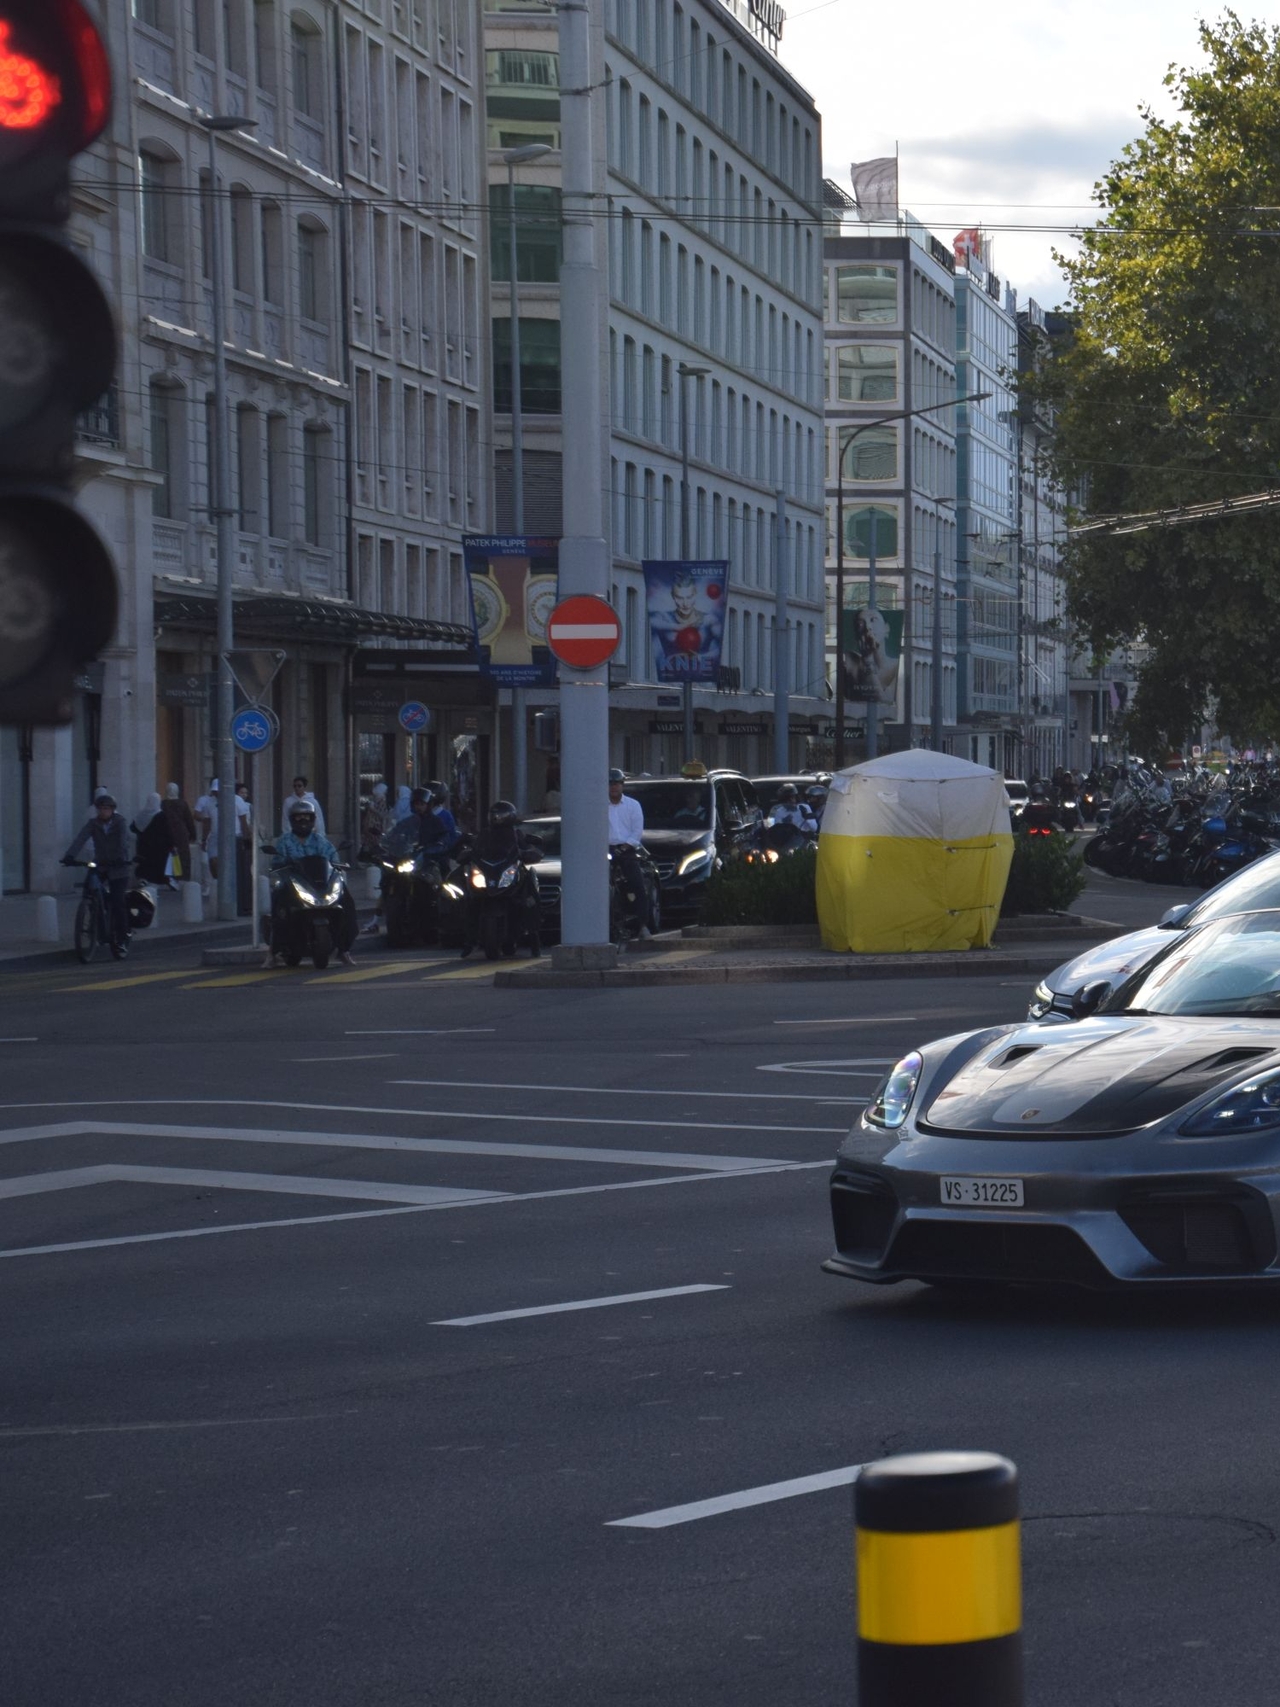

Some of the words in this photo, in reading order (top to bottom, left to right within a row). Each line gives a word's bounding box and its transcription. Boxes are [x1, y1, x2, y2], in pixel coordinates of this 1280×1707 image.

[465, 539, 490, 547] PATEK
[491, 539, 526, 547] PHILIPPE
[660, 655, 714, 671] KNIE
[826, 727, 862, 738] Catier
